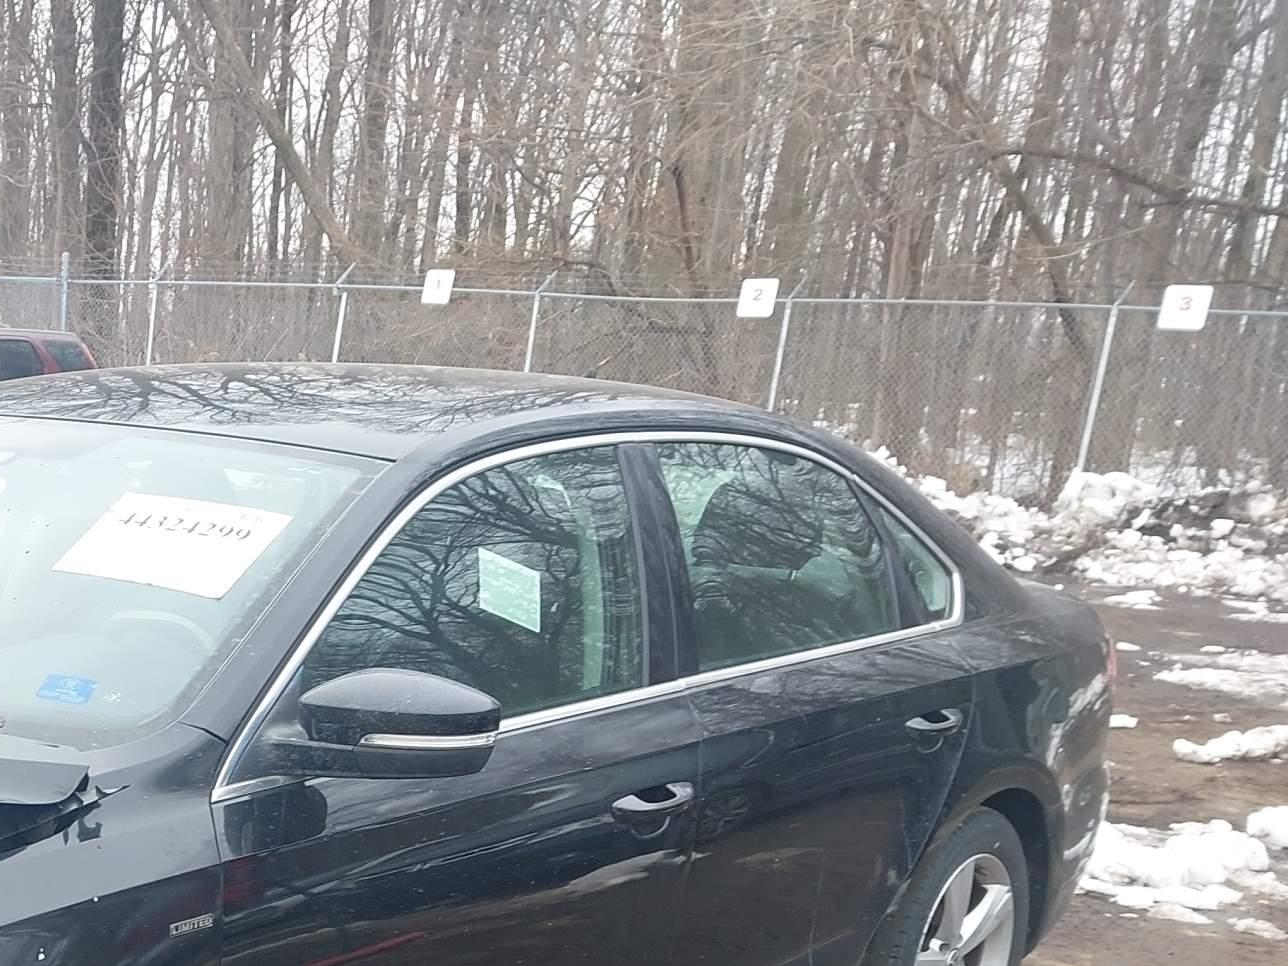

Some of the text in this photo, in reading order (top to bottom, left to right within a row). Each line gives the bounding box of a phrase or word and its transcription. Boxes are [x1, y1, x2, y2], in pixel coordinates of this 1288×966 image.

[752, 288, 764, 301] 2
[1179, 296, 1193, 311] 3
[171, 915, 213, 936] LIMITED
